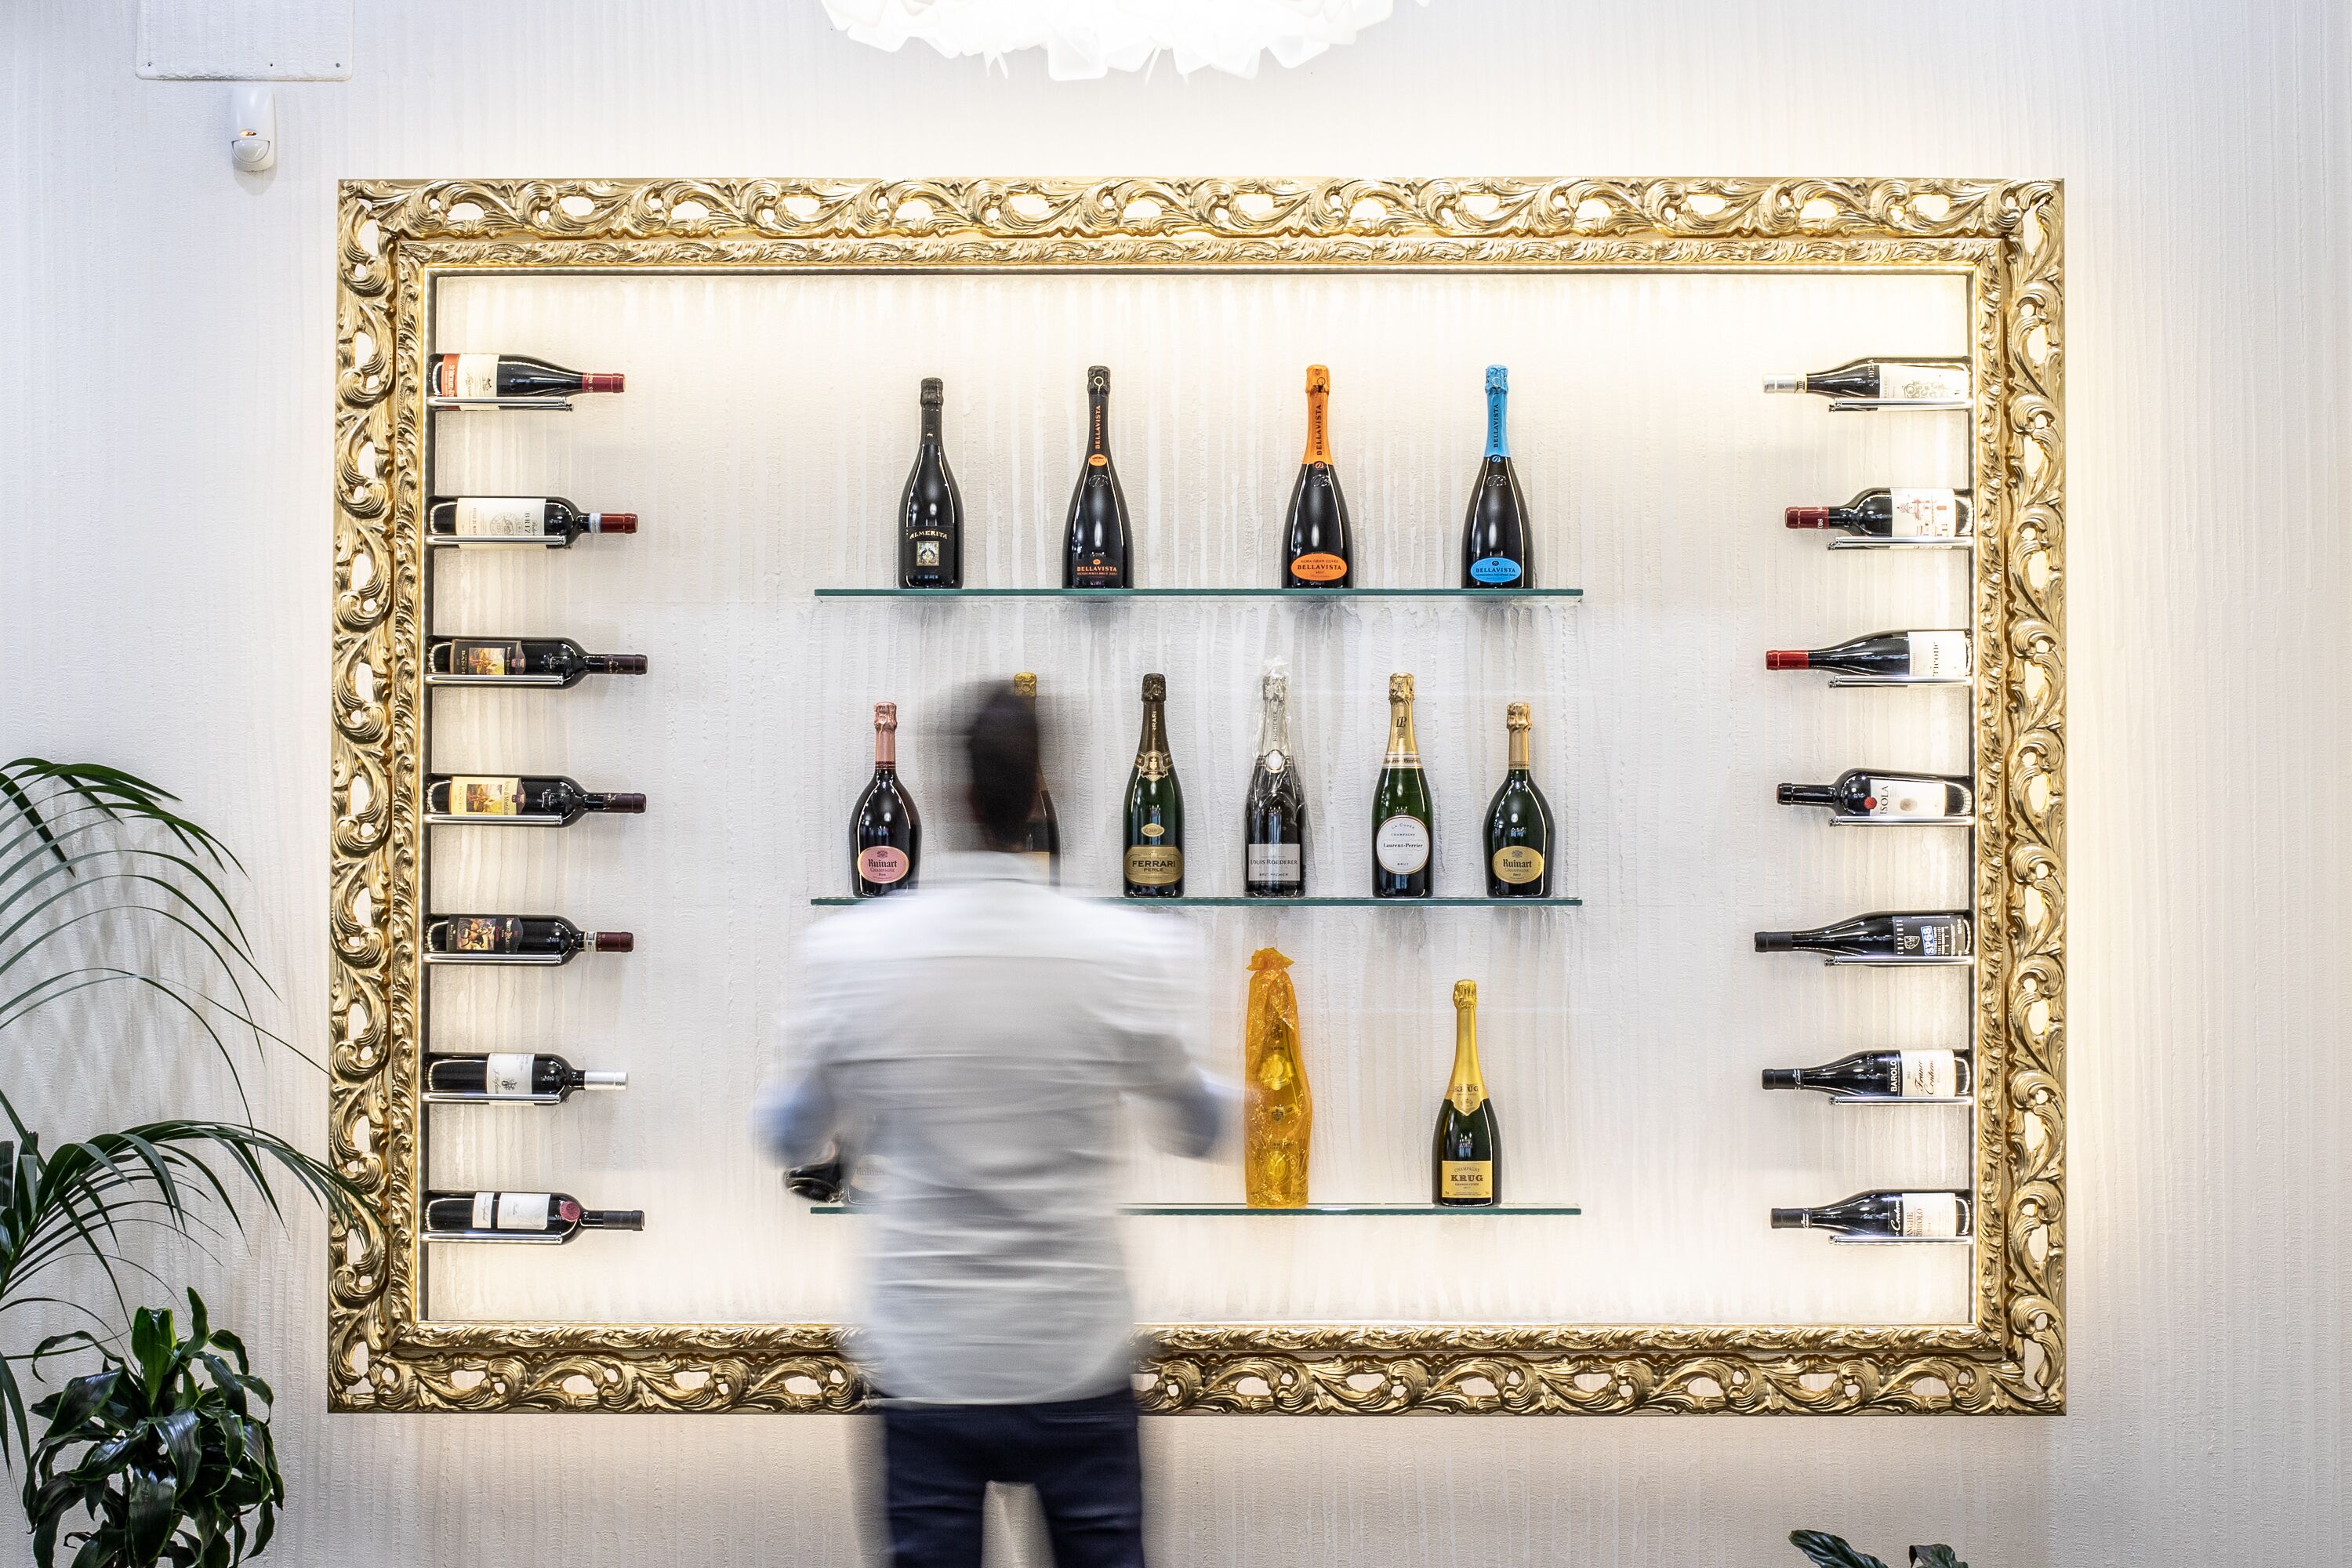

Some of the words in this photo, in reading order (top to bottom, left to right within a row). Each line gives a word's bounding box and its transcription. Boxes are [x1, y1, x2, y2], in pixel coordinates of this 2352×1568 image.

[909, 529, 948, 539] ALMERITA
[868, 858, 897, 868] Ruinart
[1503, 858, 1532, 868] Ruinart
[1896, 920, 1904, 955] CHIPINTI
[1922, 927, 1935, 954] SP68
